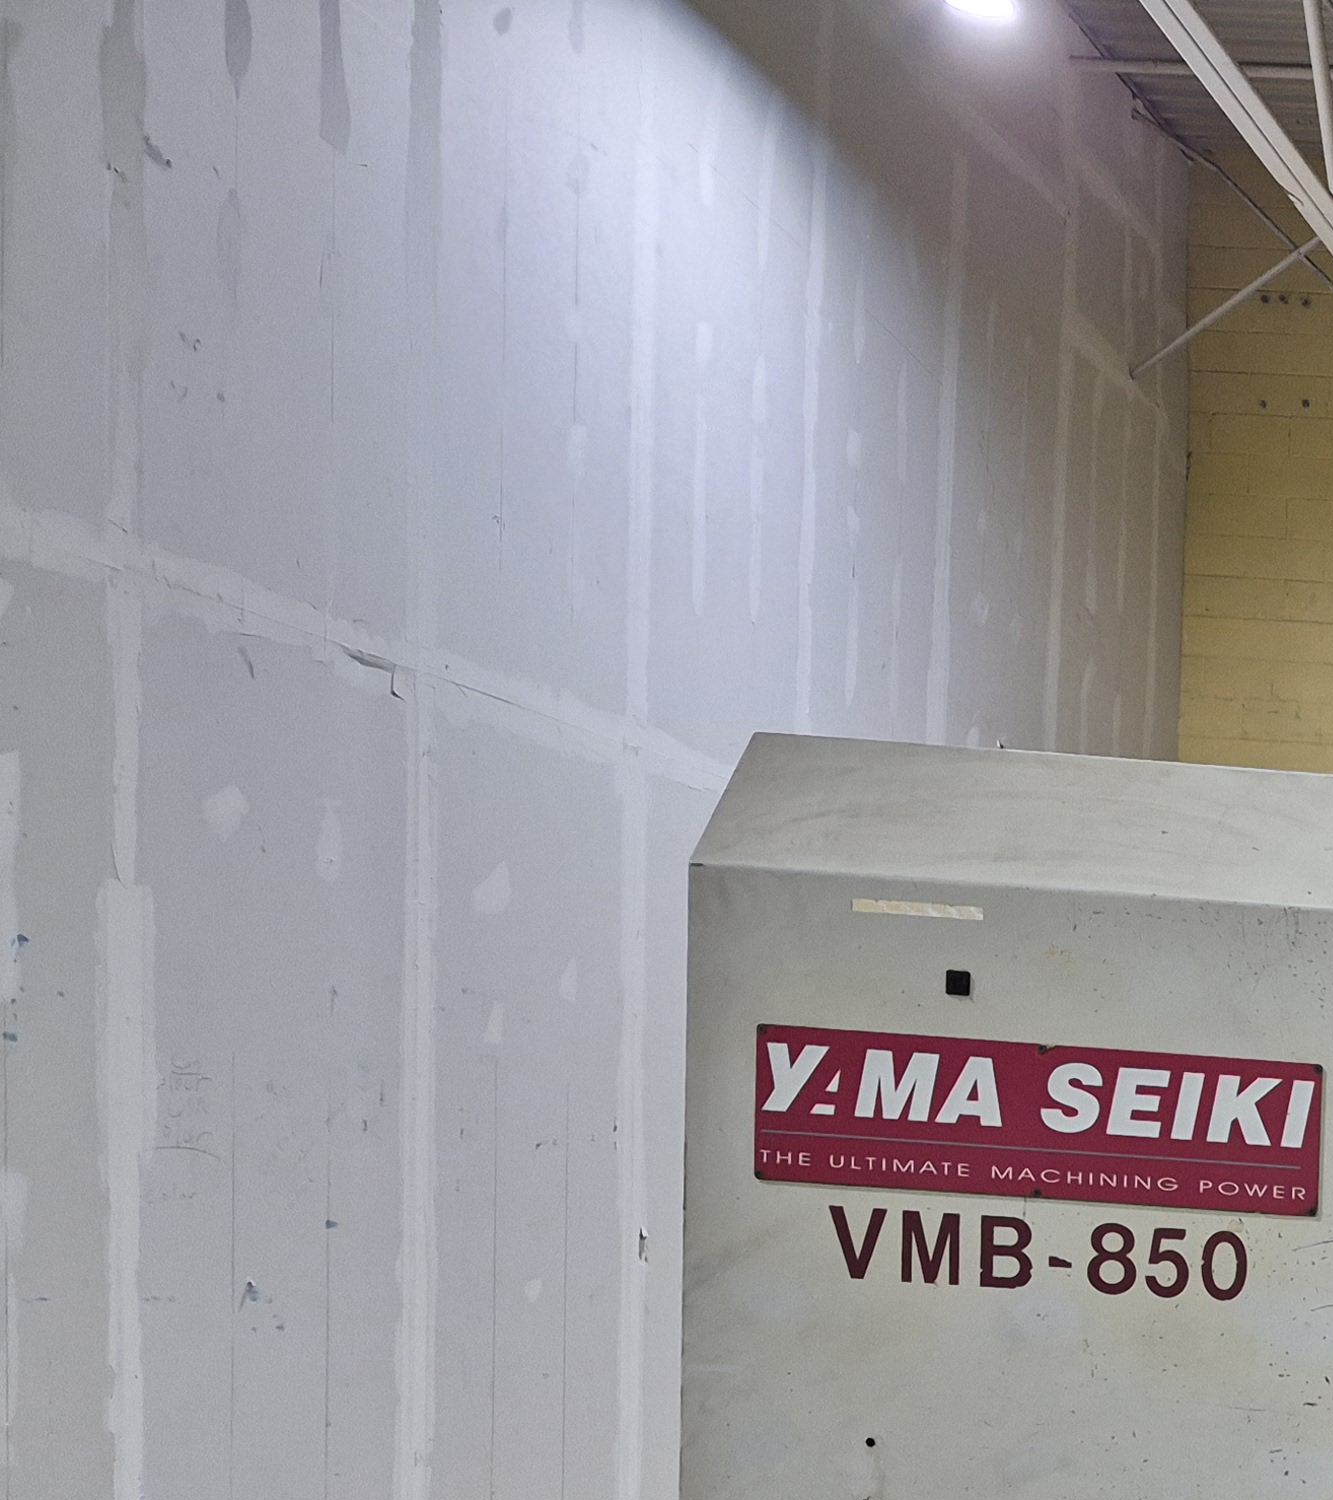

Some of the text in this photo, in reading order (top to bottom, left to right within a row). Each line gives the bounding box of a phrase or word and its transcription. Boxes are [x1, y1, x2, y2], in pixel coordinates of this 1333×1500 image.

[761, 1042, 1316, 1149] YAMA SEIKI
[759, 1149, 1308, 1201] THE ULTIMATE MACHINING POWER
[829, 1204, 1248, 1301] VMB-850
